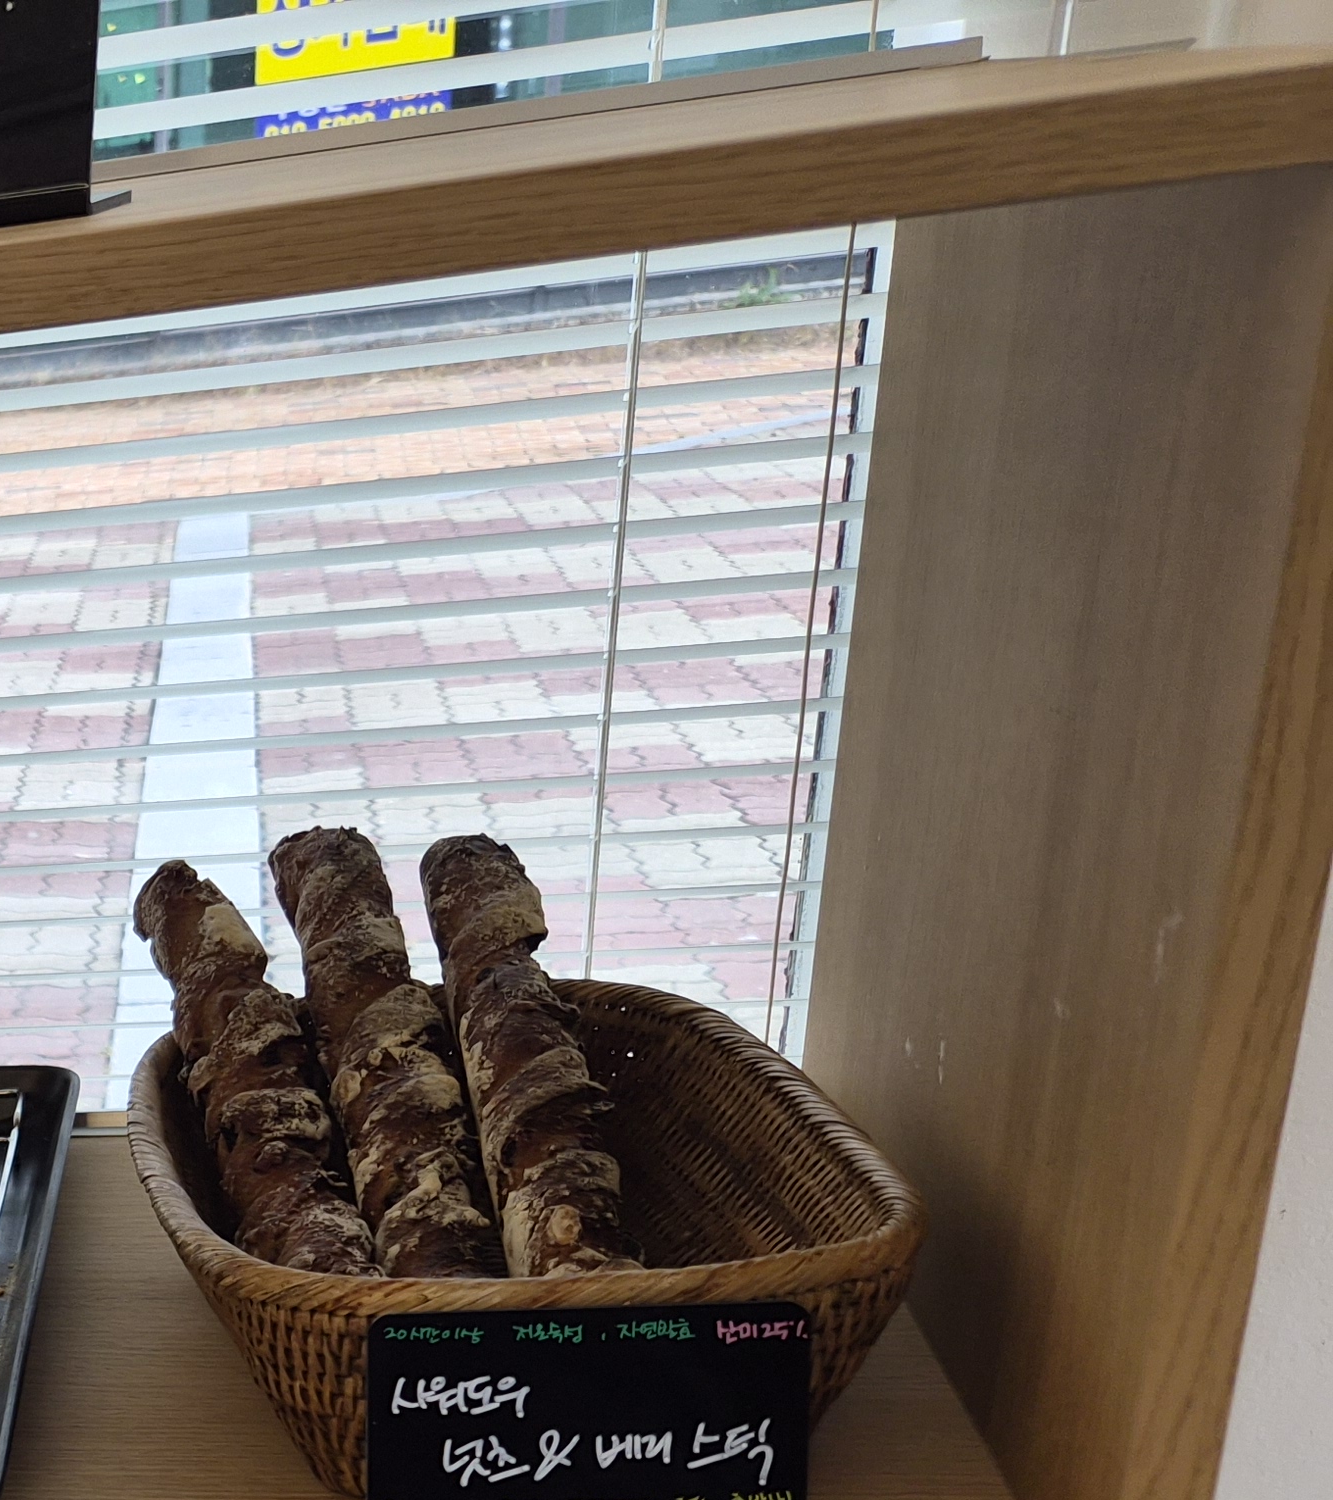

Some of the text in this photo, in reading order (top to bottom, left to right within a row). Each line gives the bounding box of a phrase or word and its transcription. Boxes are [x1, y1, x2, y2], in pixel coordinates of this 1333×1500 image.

[391, 1374, 531, 1419] 사워도우
[533, 1428, 580, 1481] &
[595, 1431, 673, 1470] 베리
[686, 1417, 775, 1486] 스틱
